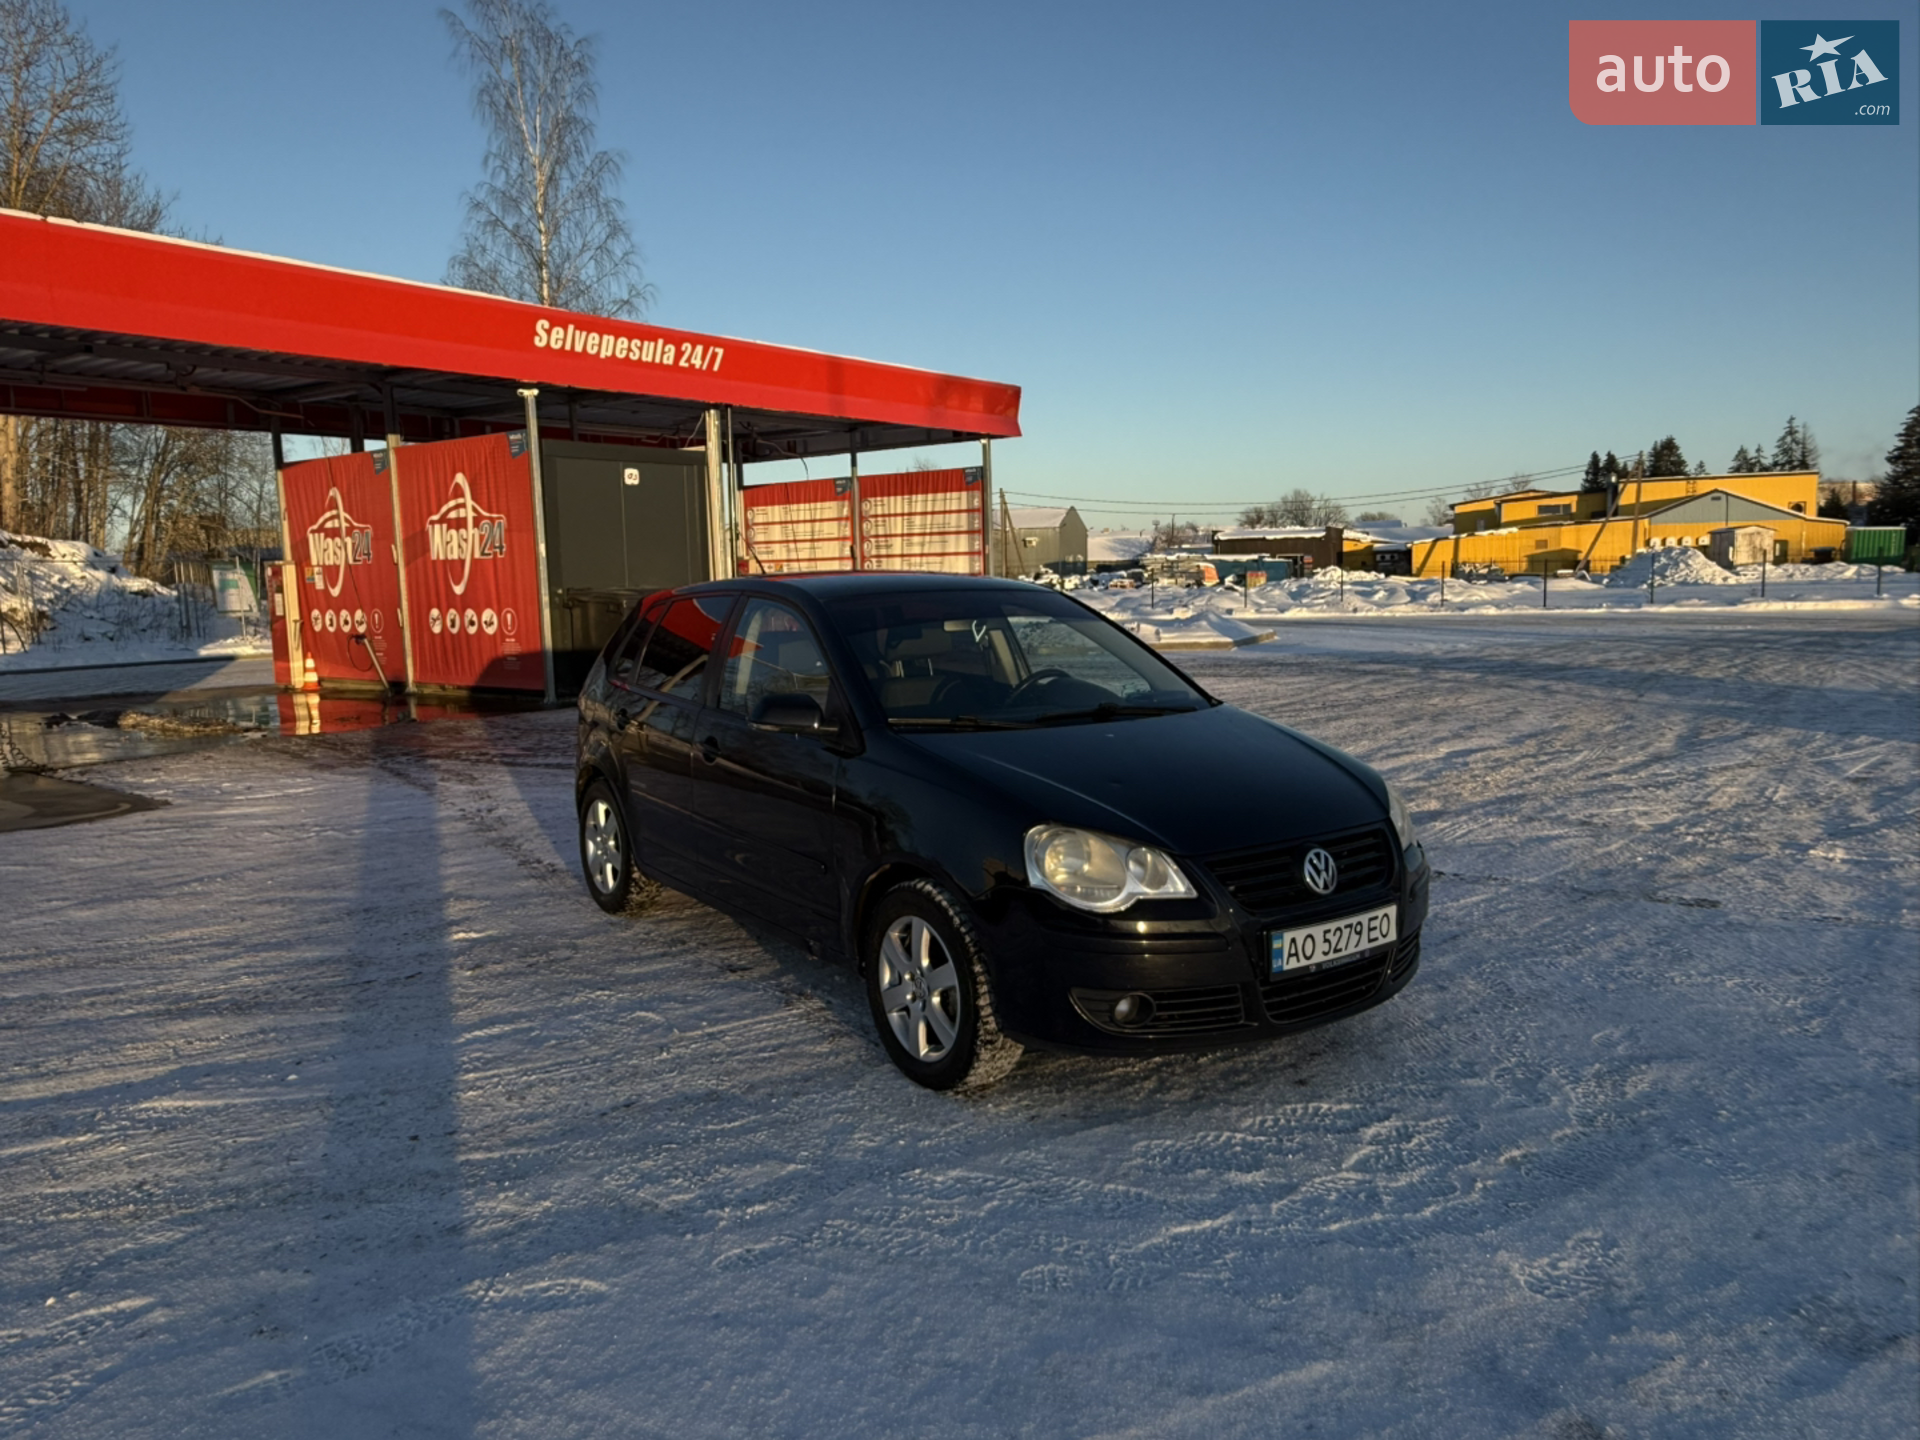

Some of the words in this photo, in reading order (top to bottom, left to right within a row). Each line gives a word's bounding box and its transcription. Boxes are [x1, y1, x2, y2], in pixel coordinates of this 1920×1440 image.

[533, 319, 676, 366] Selvepesula
[678, 342, 725, 372] 24/7
[1286, 933, 1316, 965] AO
[1321, 921, 1363, 956] 5279
[1367, 913, 1391, 944] EO
